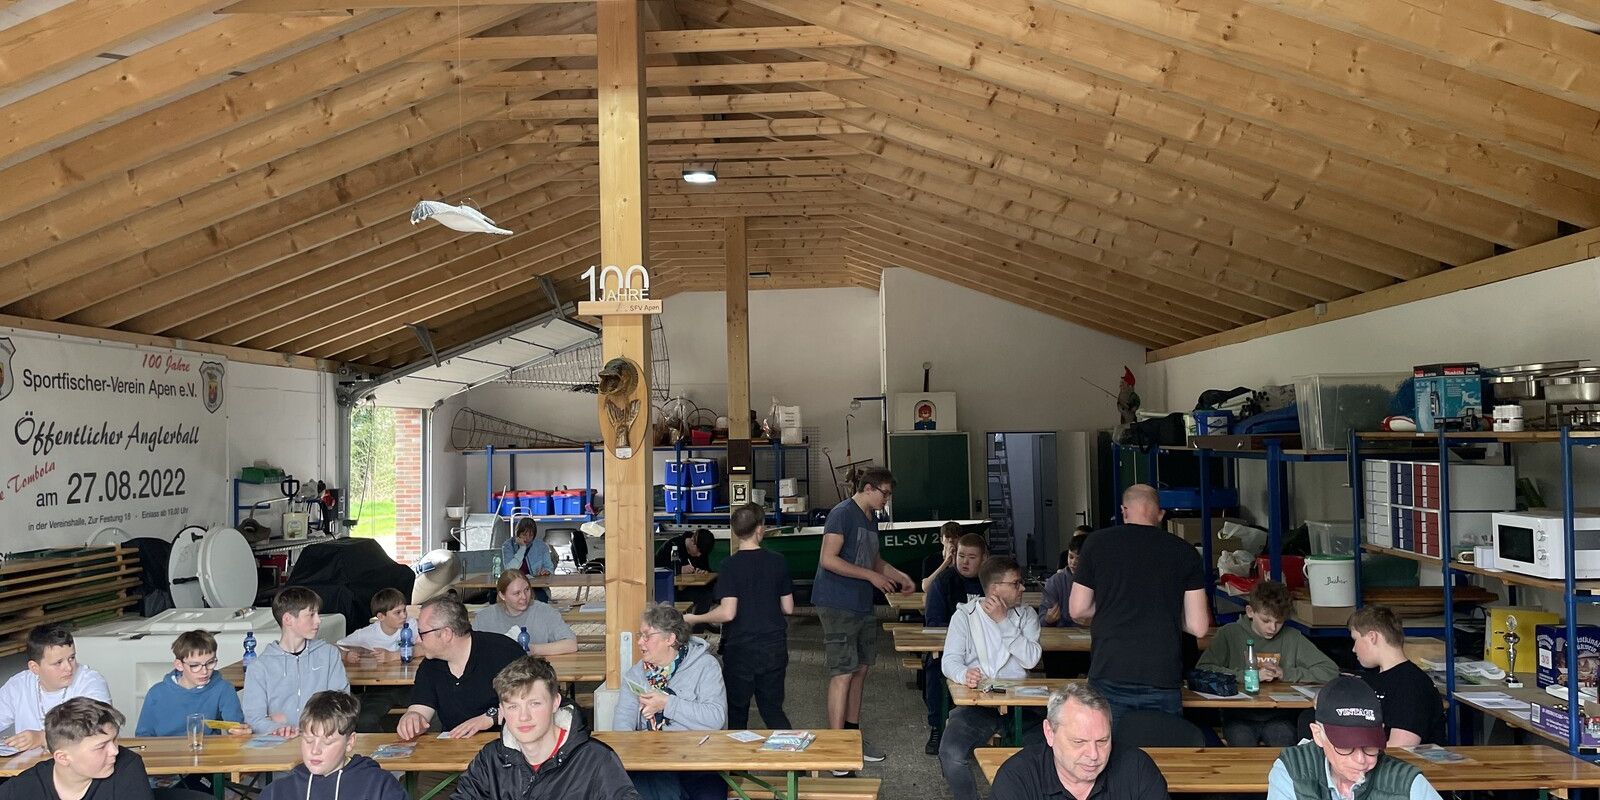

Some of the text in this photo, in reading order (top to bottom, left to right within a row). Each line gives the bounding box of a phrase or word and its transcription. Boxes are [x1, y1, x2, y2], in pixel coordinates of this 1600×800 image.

[580, 264, 650, 302] 100
[598, 288, 650, 302] JAHRE
[142, 353, 162, 369] 100
[164, 355, 190, 374] Jahre
[23, 368, 197, 399] Sportfischer-Verein Apen e.V.
[14, 410, 200, 456] Öffentlicher Anglerball
[6, 461, 56, 493] Tombola
[36, 467, 186, 507] am 27.08.2022
[28, 521, 35, 531] in
[35, 521, 48, 531] der
[88, 515, 99, 525] Zur
[884, 532, 942, 547] EL-SV 2
